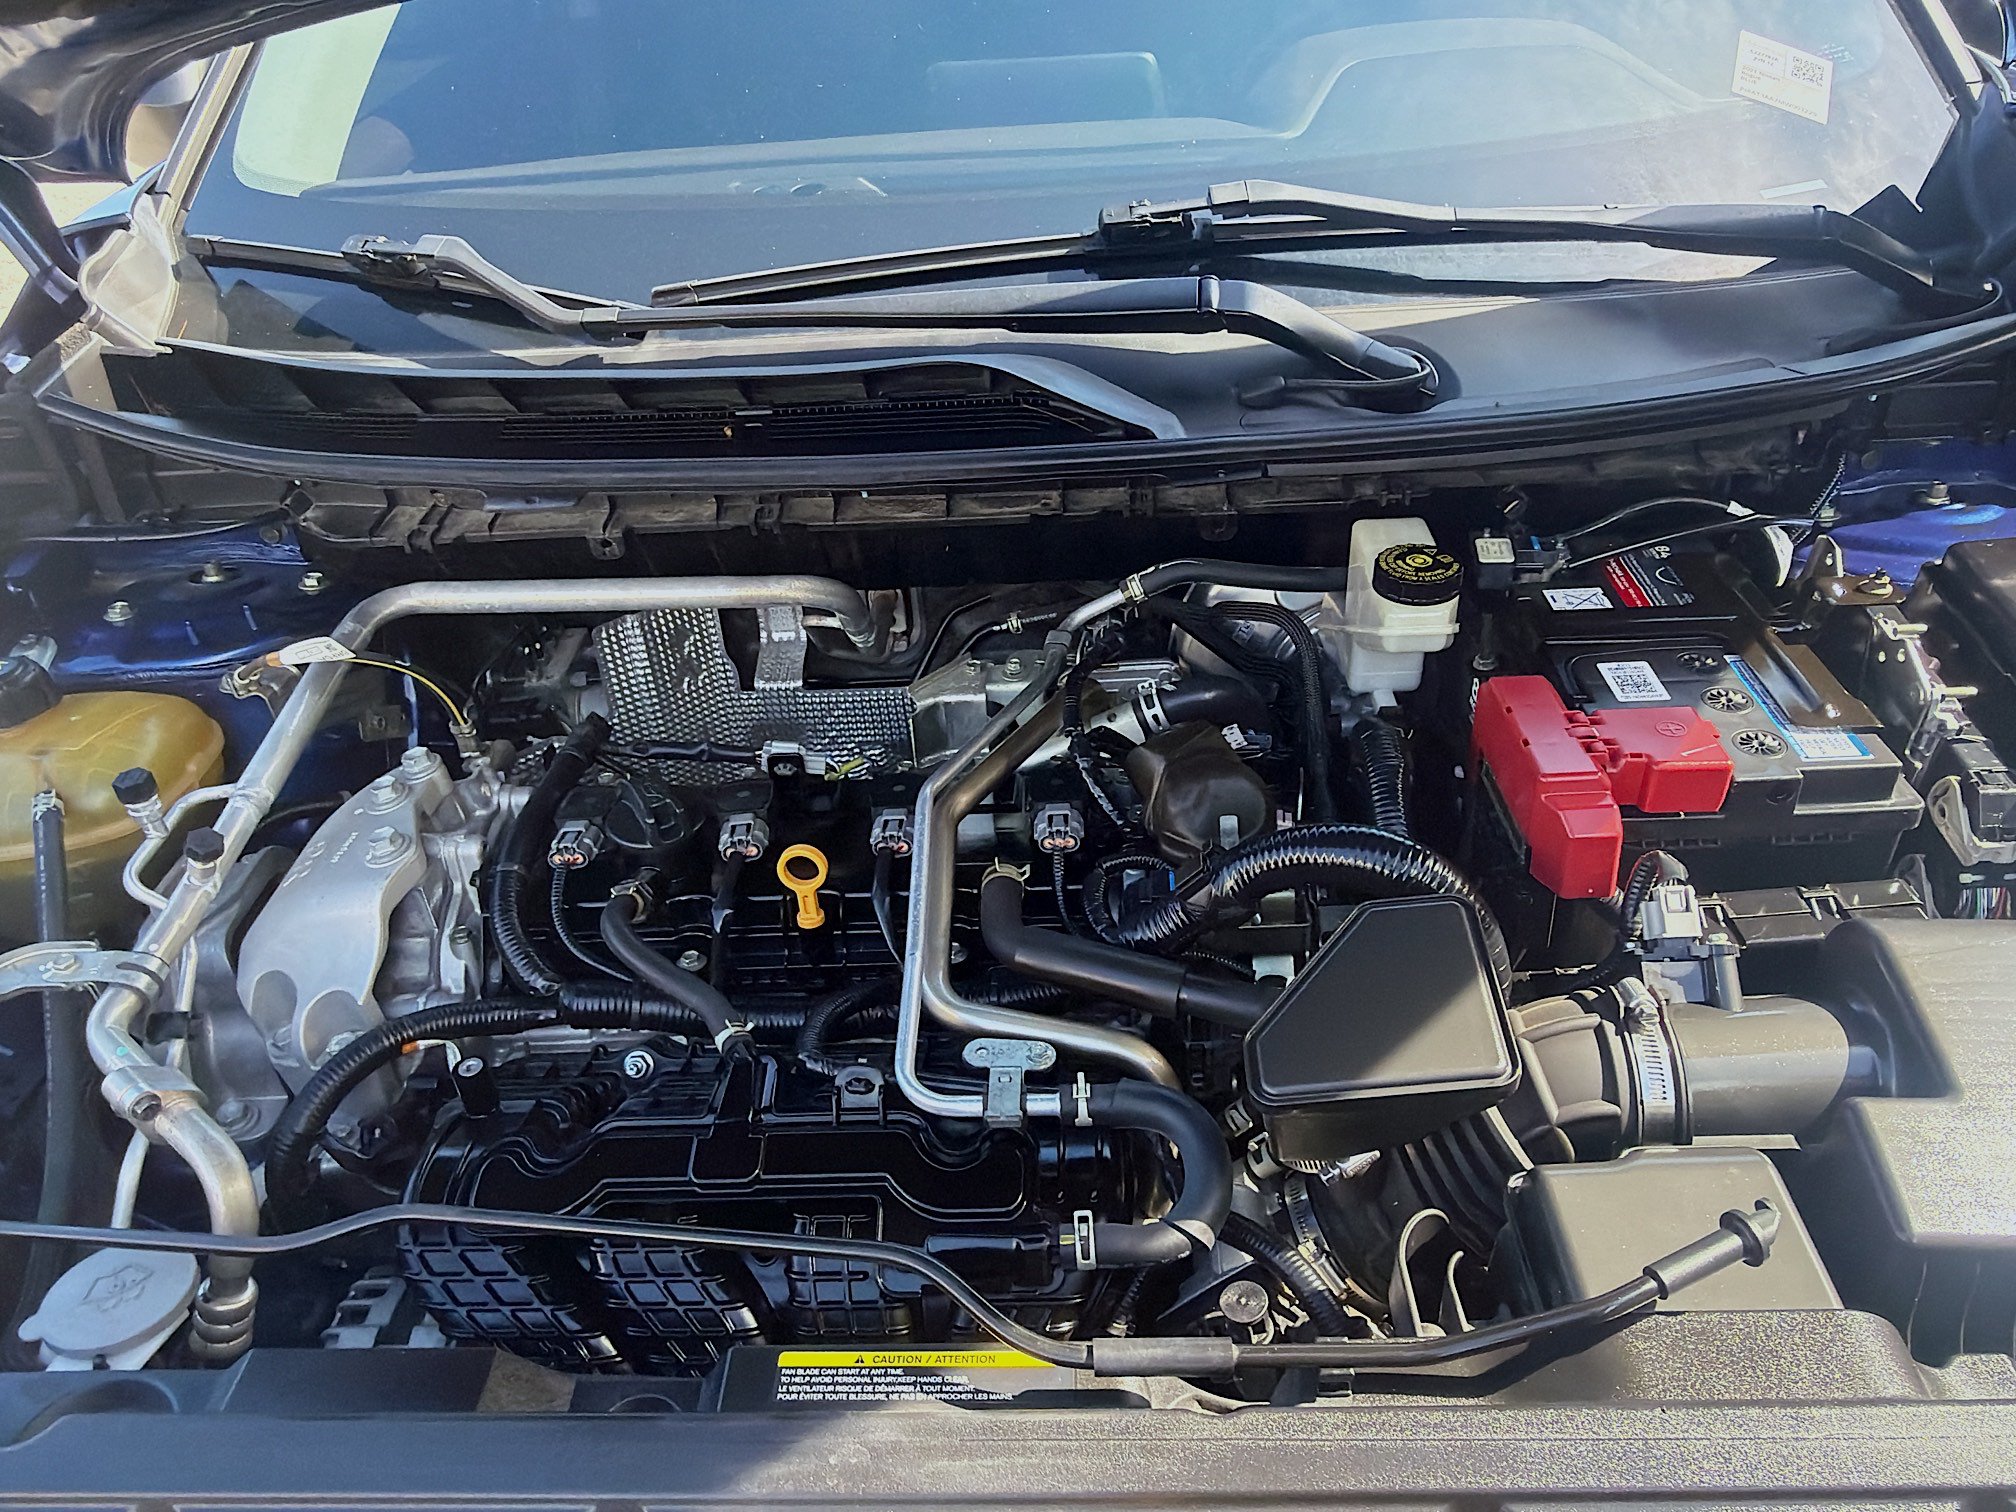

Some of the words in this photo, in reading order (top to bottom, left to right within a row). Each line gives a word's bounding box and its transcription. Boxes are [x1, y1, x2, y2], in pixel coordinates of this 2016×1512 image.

[872, 1355, 922, 1364] CAUTION
[935, 1355, 996, 1364] ATTENTION
[915, 1383, 922, 1392] À
[799, 1391, 824, 1400] ÉVITER
